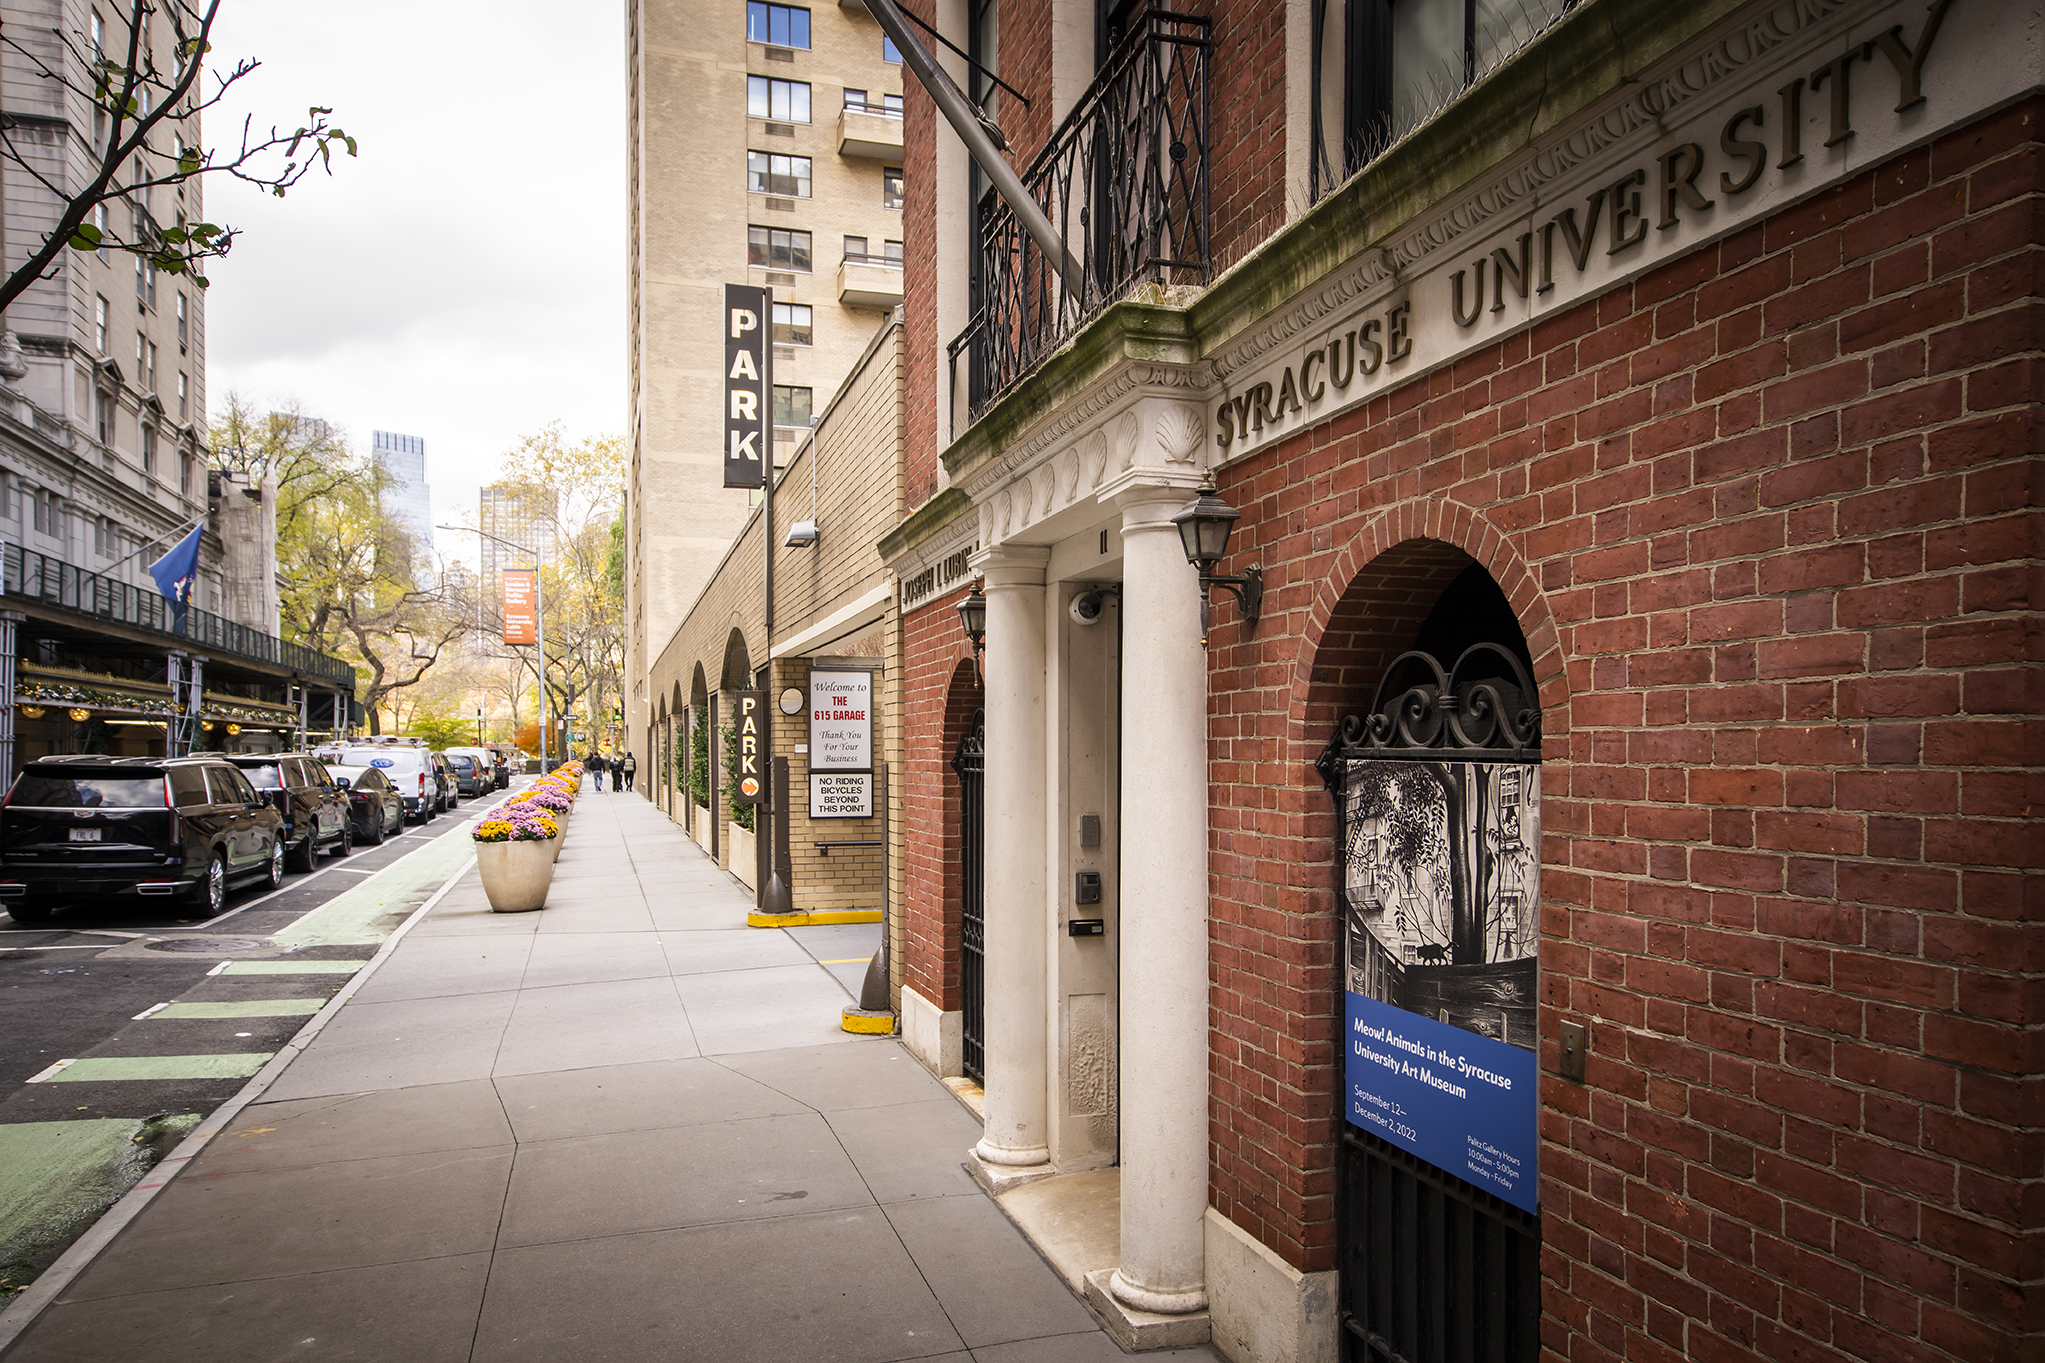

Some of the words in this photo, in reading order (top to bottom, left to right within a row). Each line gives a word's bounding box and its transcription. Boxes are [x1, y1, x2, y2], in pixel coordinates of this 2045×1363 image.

[1216, 300, 1412, 447] SYRACUSE
[1448, 0, 1953, 327] UNIVERSITY
[729, 308, 759, 460] PARK
[903, 567, 934, 604] JOSEPH
[814, 682, 855, 692] Welcome
[857, 684, 867, 692] to
[832, 696, 848, 706] THE
[814, 710, 830, 721] 615
[833, 710, 866, 721] GARAGE
[742, 697, 757, 774] PARK
[819, 729, 845, 741] Thank
[846, 730, 862, 739] You
[823, 743, 838, 751] For
[839, 743, 859, 751] Your
[824, 754, 858, 763] Business
[818, 805, 839, 813] THIS
[840, 805, 865, 813] POINT
[824, 796, 860, 804] BEYOND
[1354, 1017, 1385, 1041] Meow!
[1386, 1029, 1425, 1057] Animals
[1427, 1045, 1437, 1062] in
[1438, 1051, 1456, 1069] the
[1457, 1056, 1512, 1090] Syracuse
[1354, 1040, 1400, 1074] University
[1401, 1060, 1418, 1079] Art
[1420, 1067, 1466, 1099] Museum
[1354, 1084, 1390, 1110] September
[1354, 1101, 1388, 1127] December
[1388, 1118, 1396, 1134] 2,
[1396, 1122, 1417, 1142] 2022
[1467, 1148, 1492, 1167] 10:00am
[1496, 1160, 1520, 1179] 5:00pm
[1482, 1142, 1502, 1159] Gallery
[1502, 1150, 1521, 1166] Hours
[1467, 1160, 1490, 1180] Monday
[1494, 1172, 1513, 1191] Friday
